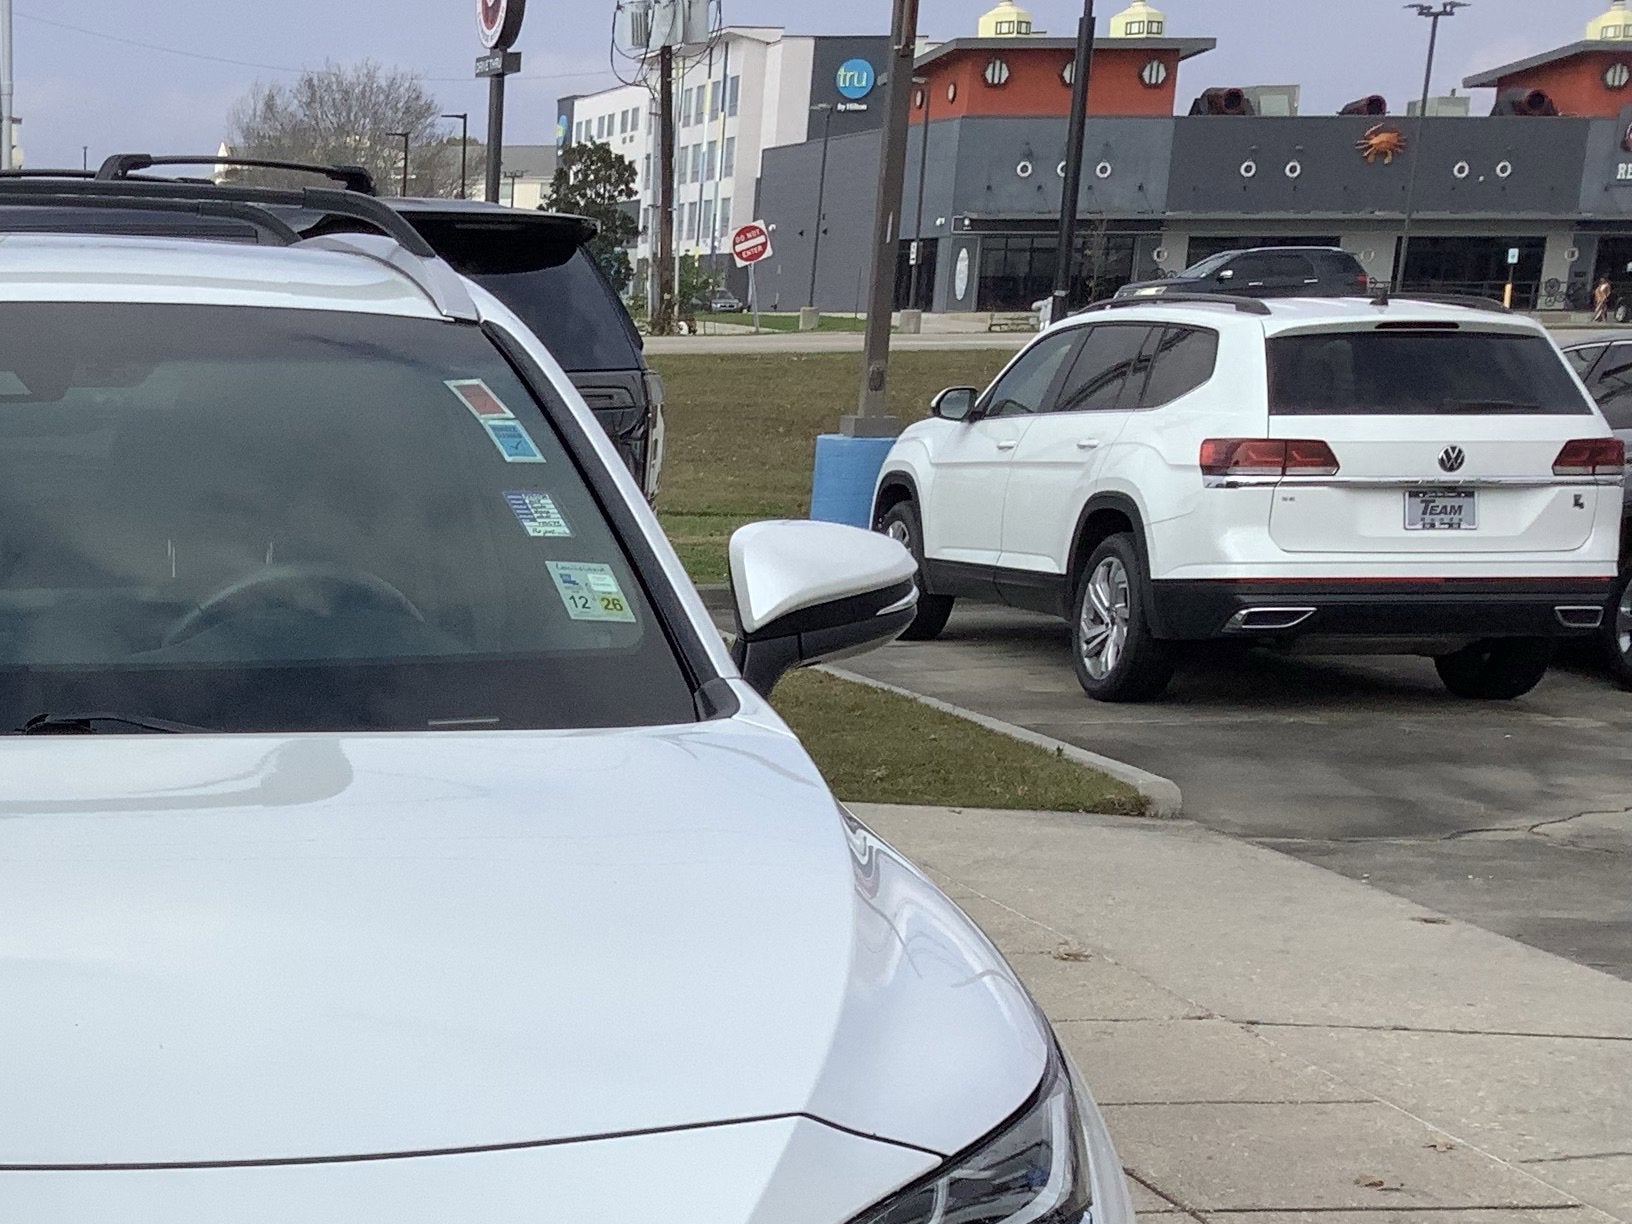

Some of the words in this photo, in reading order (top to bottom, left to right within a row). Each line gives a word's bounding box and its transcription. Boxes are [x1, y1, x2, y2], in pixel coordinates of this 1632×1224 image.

[838, 66, 867, 87] tru
[735, 234, 746, 243] DO
[746, 229, 760, 239] NOT
[741, 245, 764, 258] ENTER
[569, 595, 591, 609] 12
[600, 597, 623, 611] 26
